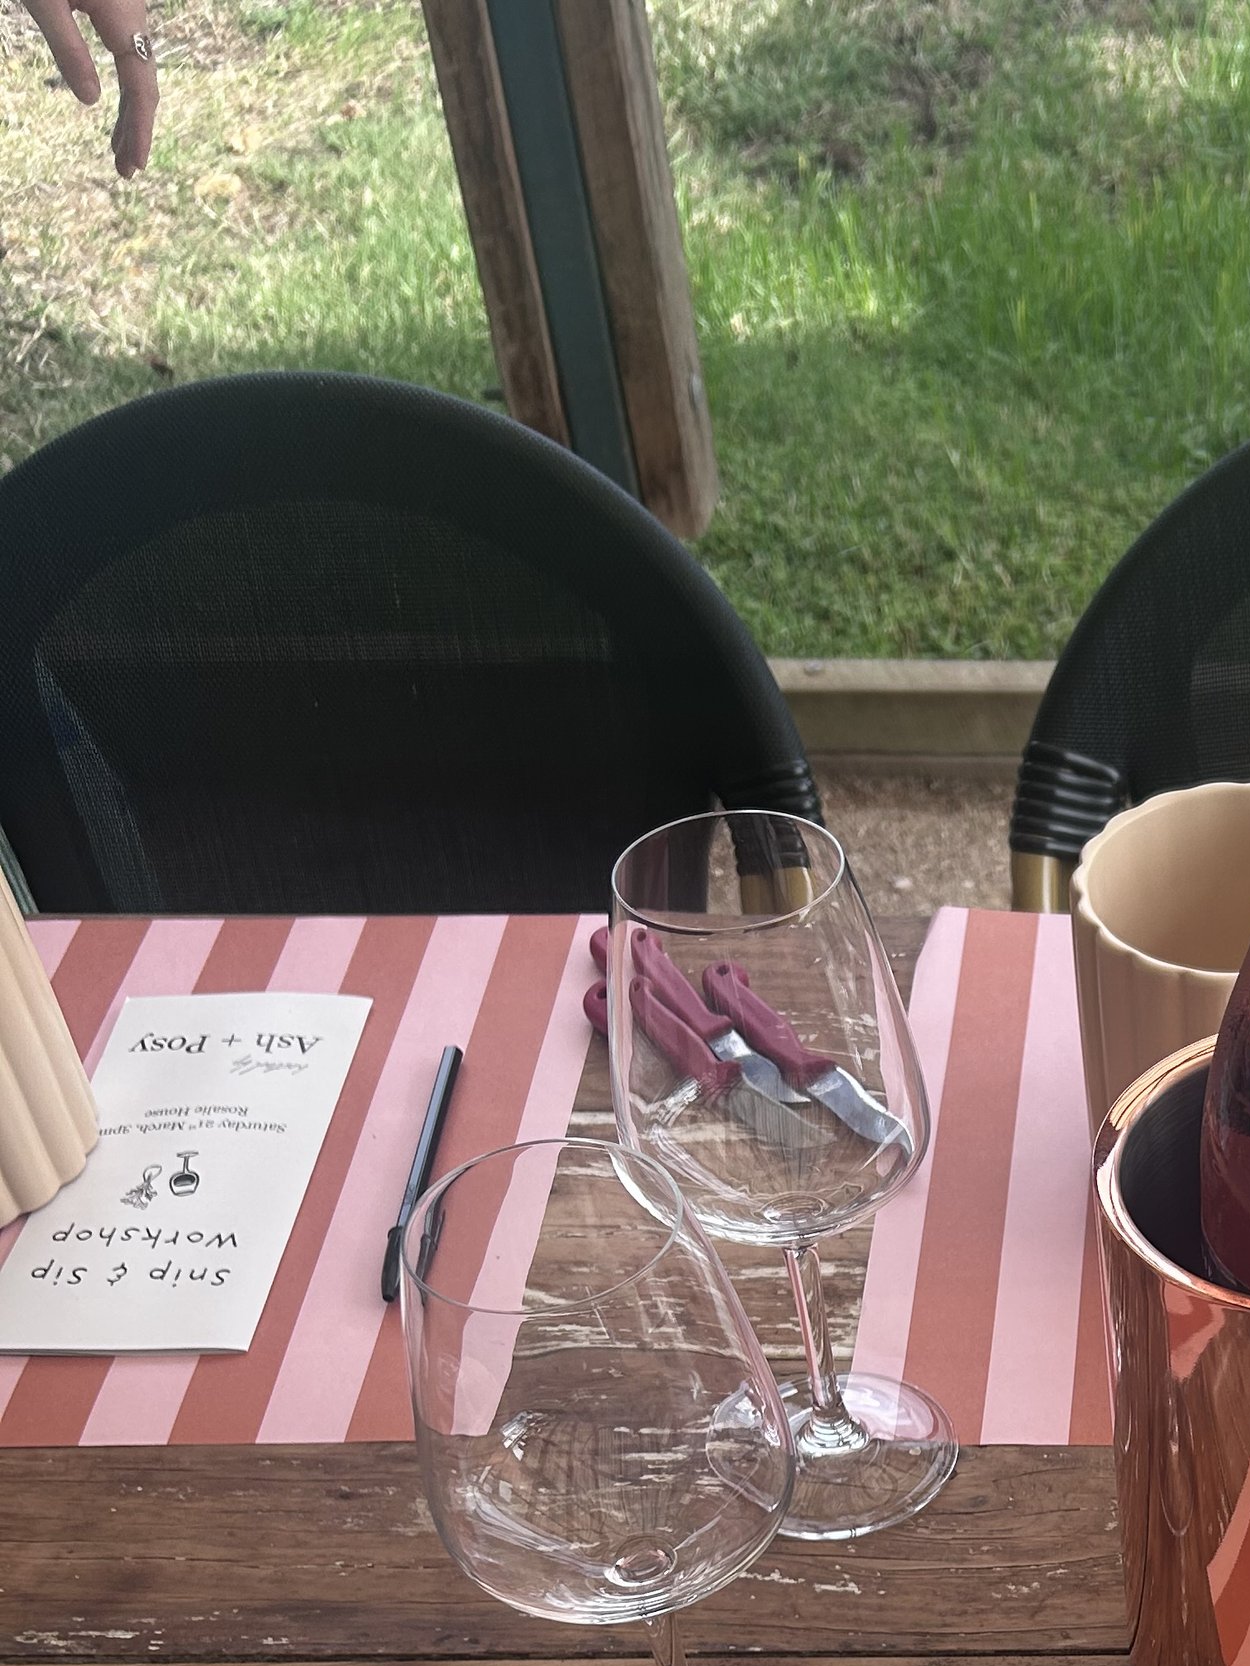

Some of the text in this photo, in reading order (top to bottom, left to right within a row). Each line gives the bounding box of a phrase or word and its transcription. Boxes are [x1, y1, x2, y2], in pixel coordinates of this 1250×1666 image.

[128, 1031, 324, 1055] Ash + Posy
[144, 1104, 191, 1119] House
[217, 1117, 288, 1133] Saturday
[51, 1222, 238, 1249] Workshop
[30, 1258, 231, 1288] Snip & Sip
